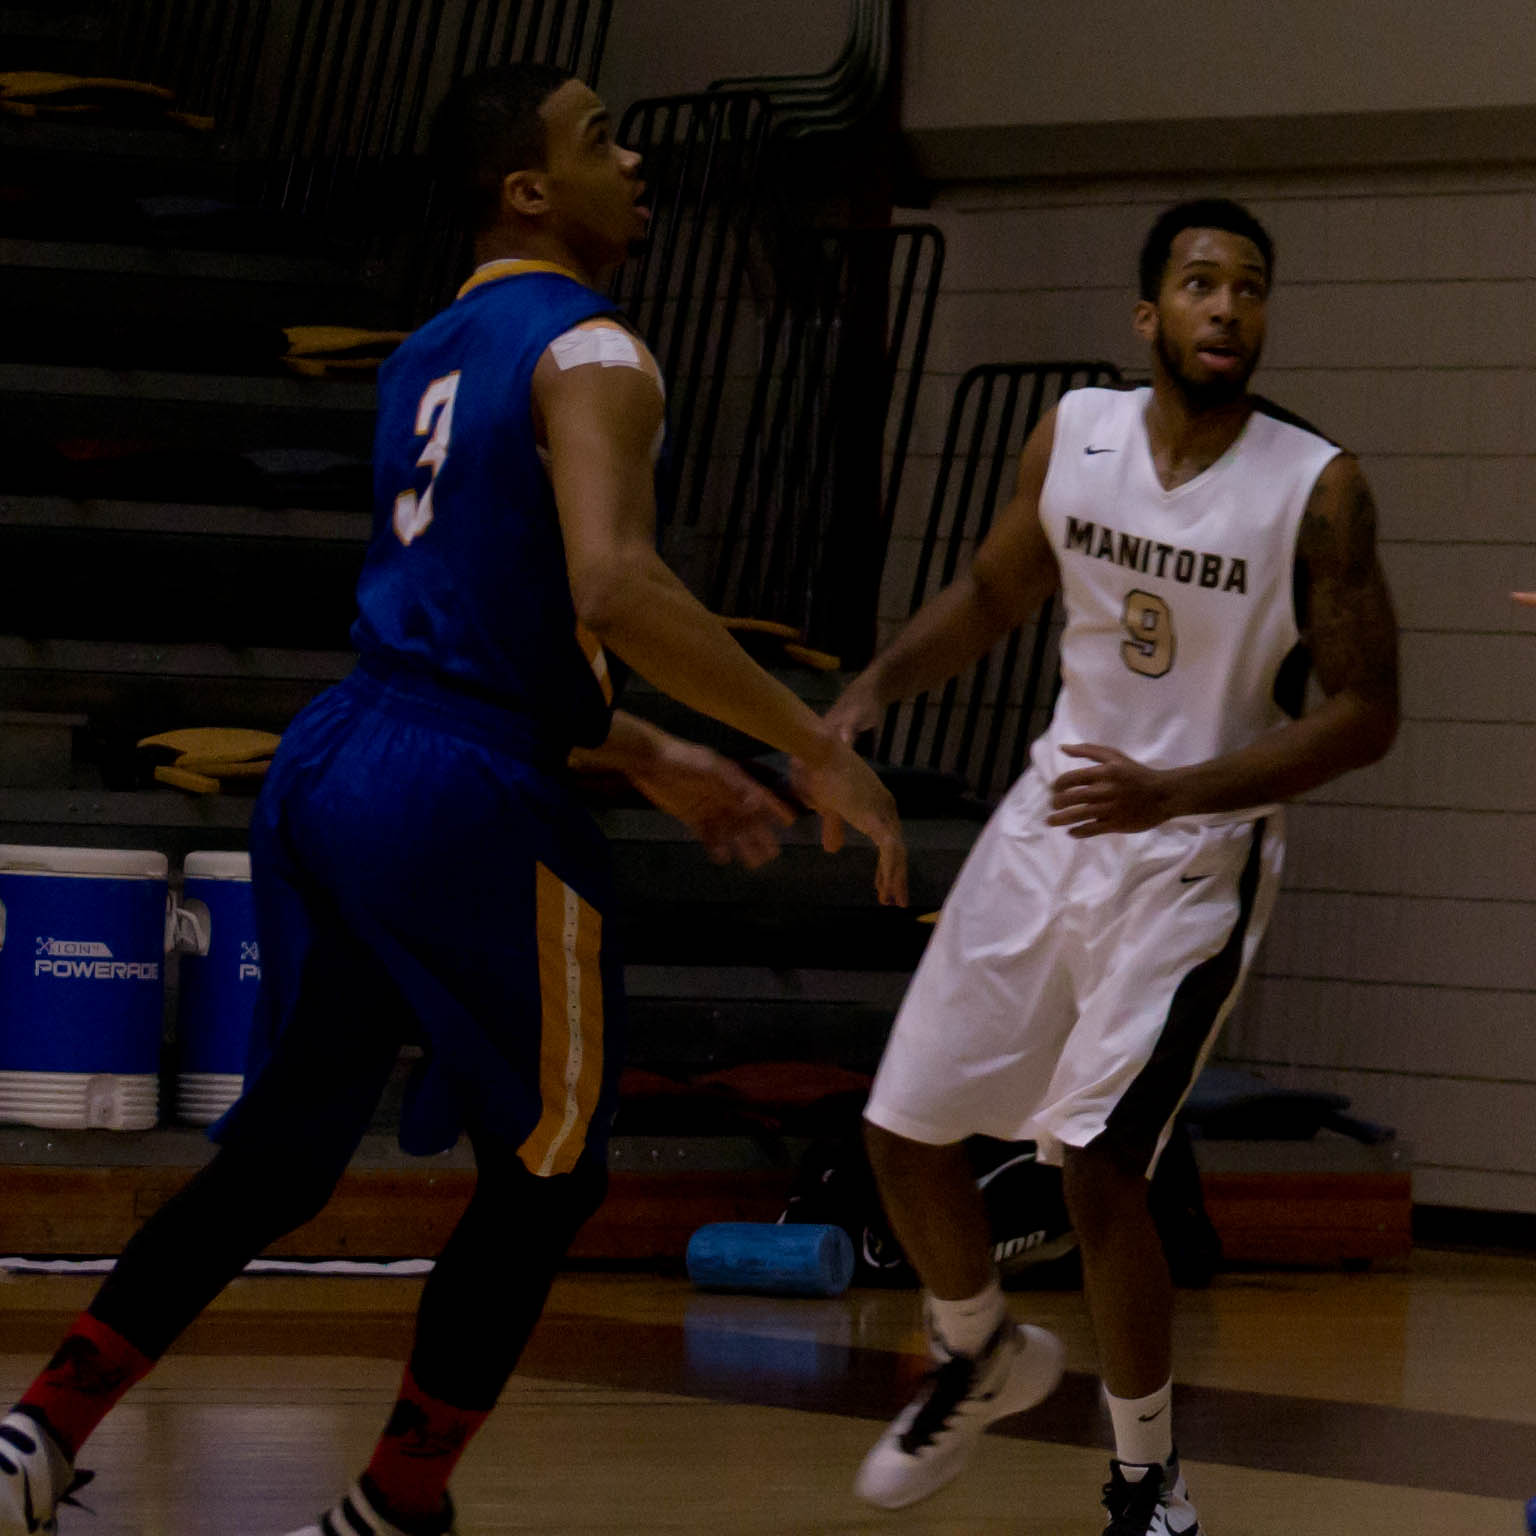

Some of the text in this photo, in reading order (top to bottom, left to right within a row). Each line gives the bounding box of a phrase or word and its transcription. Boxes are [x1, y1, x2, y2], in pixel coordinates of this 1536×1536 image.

[391, 368, 463, 548] 3
[1065, 515, 1249, 596] MANITOBA
[1120, 587, 1179, 679] 9
[34, 959, 160, 982] POWERADE
